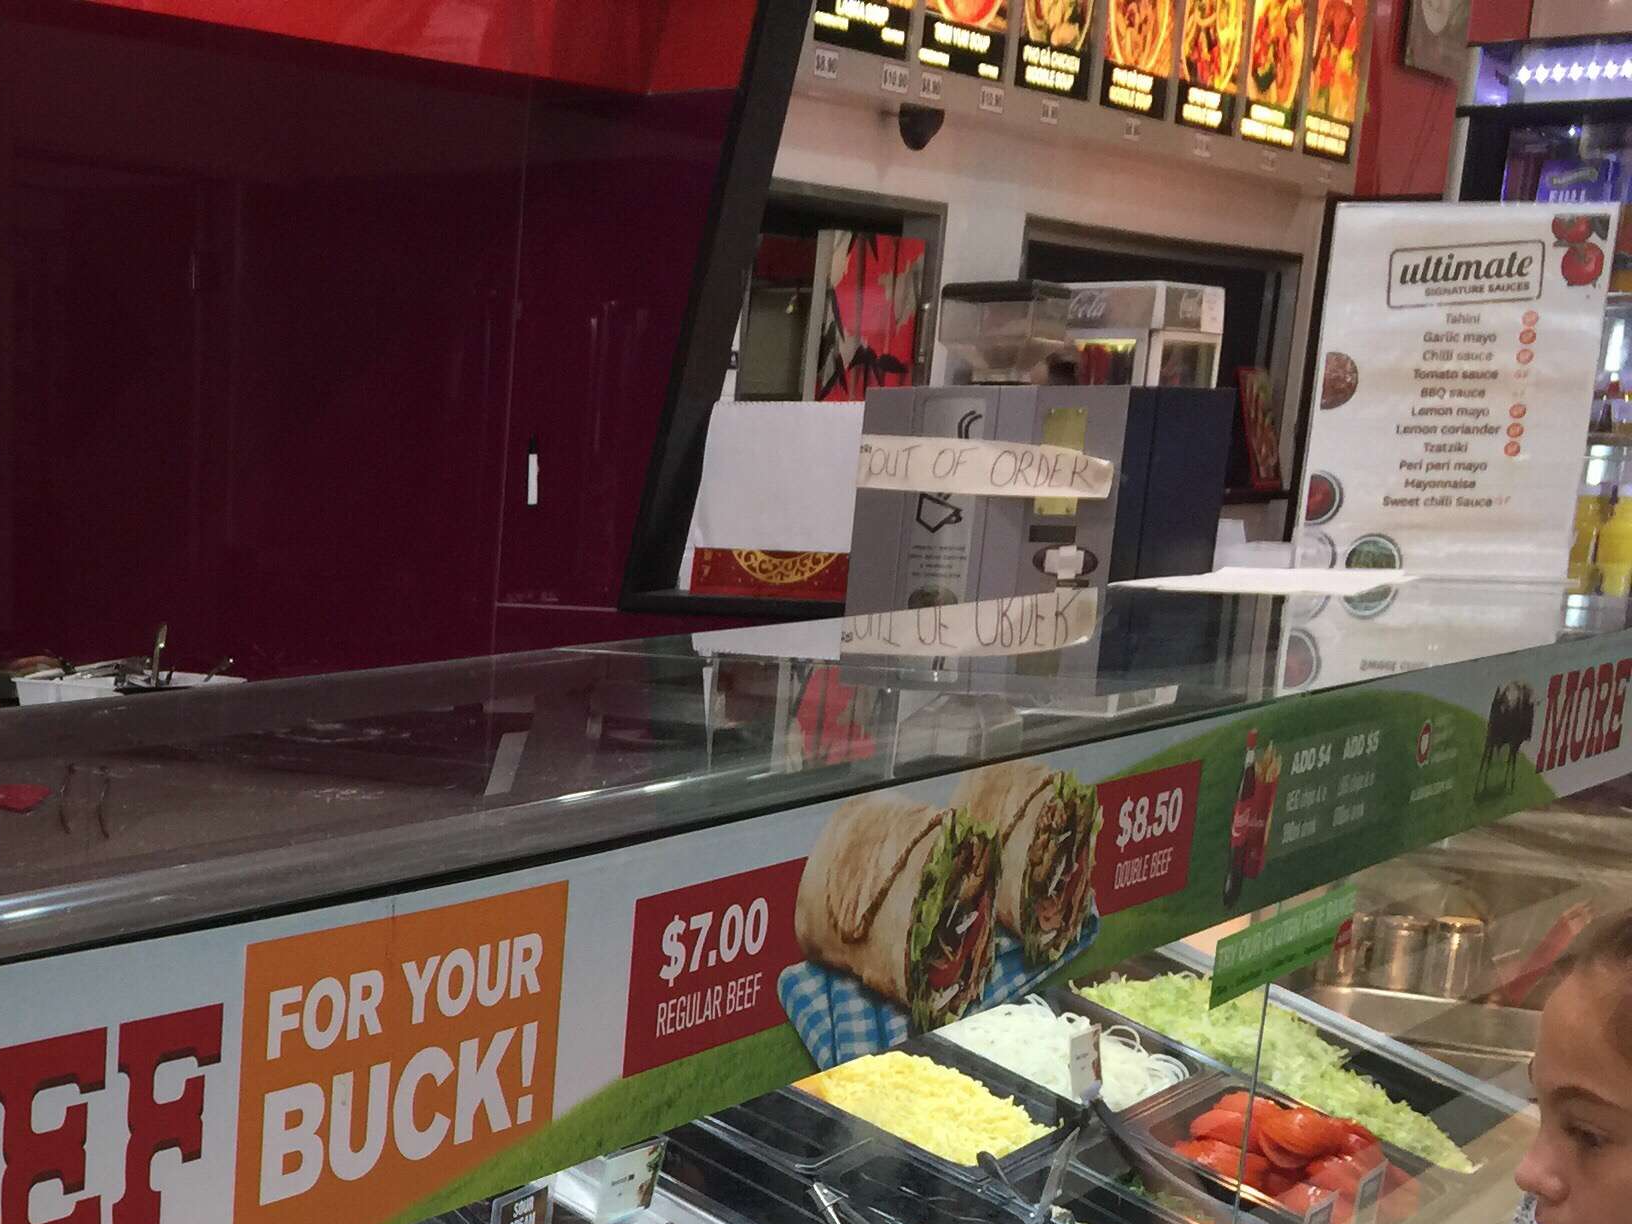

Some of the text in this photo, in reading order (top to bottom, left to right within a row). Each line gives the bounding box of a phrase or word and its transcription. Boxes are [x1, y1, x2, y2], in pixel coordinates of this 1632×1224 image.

[1399, 251, 1533, 286] ultimate
[1425, 281, 1530, 297] SIGNATURE SAUCES
[1423, 330, 1497, 346] Garlic mayo
[1422, 349, 1495, 362] Chilli sauce
[1413, 368, 1499, 380] Tomato sauce
[1420, 386, 1486, 399] BBQ sauce
[1411, 405, 1490, 420] Lemon mayo
[1396, 423, 1501, 435] Lemon coriander
[1423, 441, 1468, 453] Tzatziki
[869, 444, 1096, 489] OUT OF ORDER
[1399, 459, 1488, 473] Peri peri mayo
[1404, 478, 1476, 491] Mayonnaise
[1382, 496, 1420, 507] Sweet
[1455, 496, 1493, 507] Sauce
[1535, 657, 1632, 774] MORE
[1343, 733, 1365, 761] ADD
[1290, 747, 1316, 775] ADD
[1116, 786, 1183, 853] $8.50
[1113, 846, 1174, 891] DOUBLE BEEF
[659, 896, 769, 987] $7.00
[267, 932, 544, 1062] FOR YOUR
[655, 972, 763, 1039] REGULAR BEEF
[259, 1020, 539, 1207] BUCK!
[512, 1195, 535, 1219] SOUR
